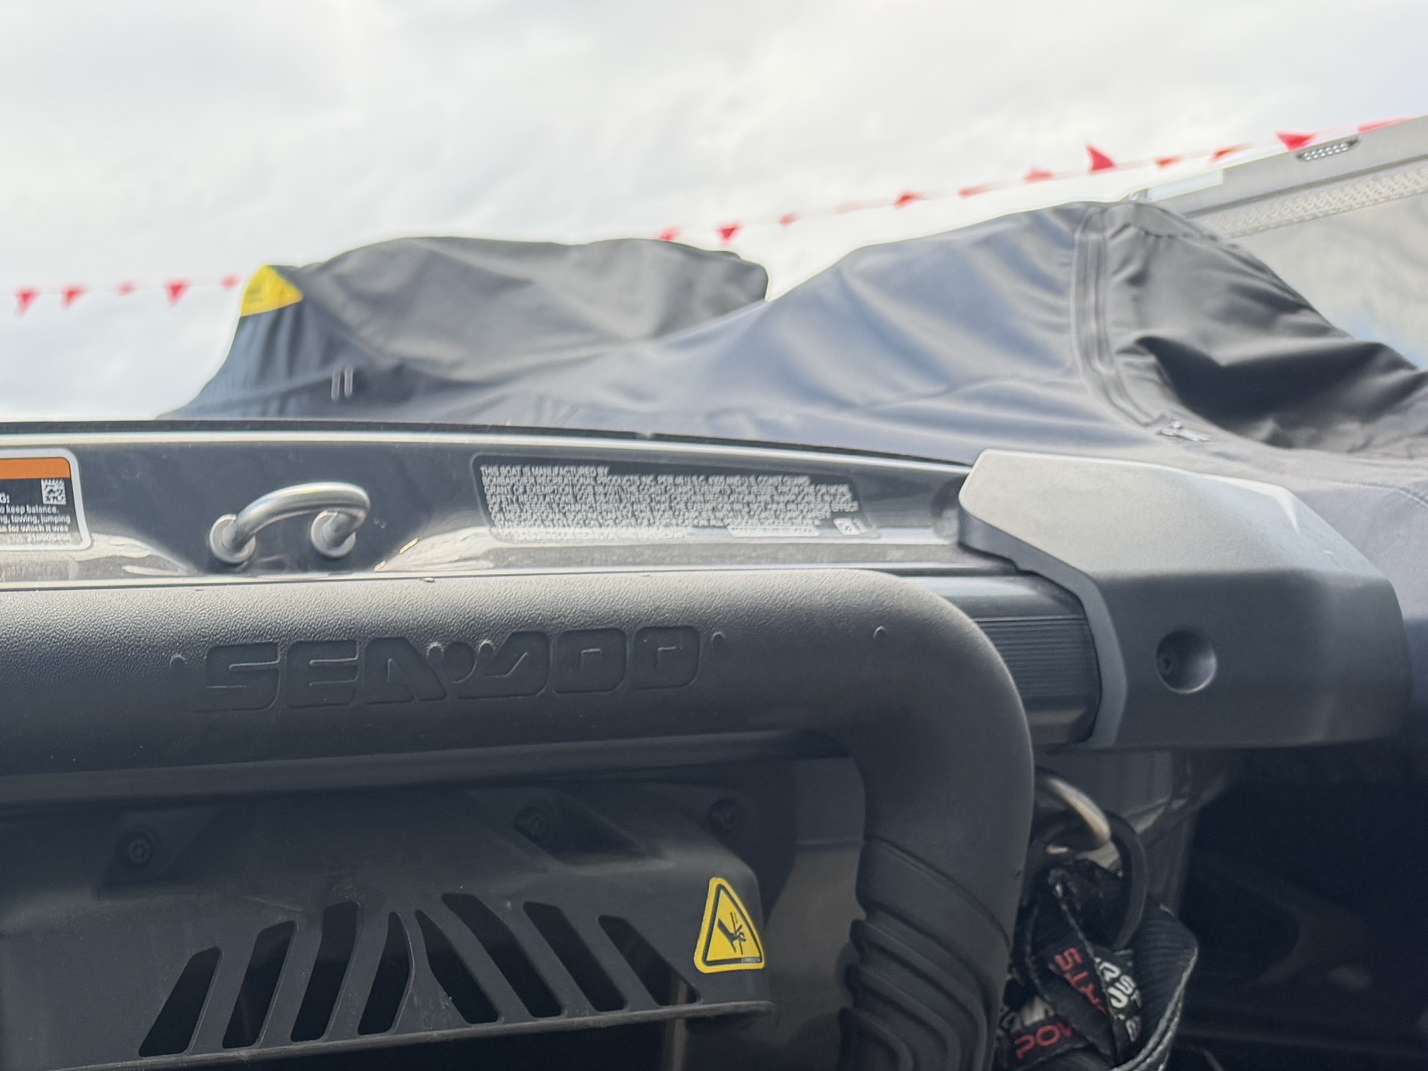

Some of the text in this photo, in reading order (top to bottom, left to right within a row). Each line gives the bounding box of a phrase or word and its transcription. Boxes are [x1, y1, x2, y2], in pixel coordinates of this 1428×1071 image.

[6, 503, 26, 516] keep
[26, 503, 59, 514] balance.
[40, 513, 71, 525] jumping
[21, 524, 44, 533] which
